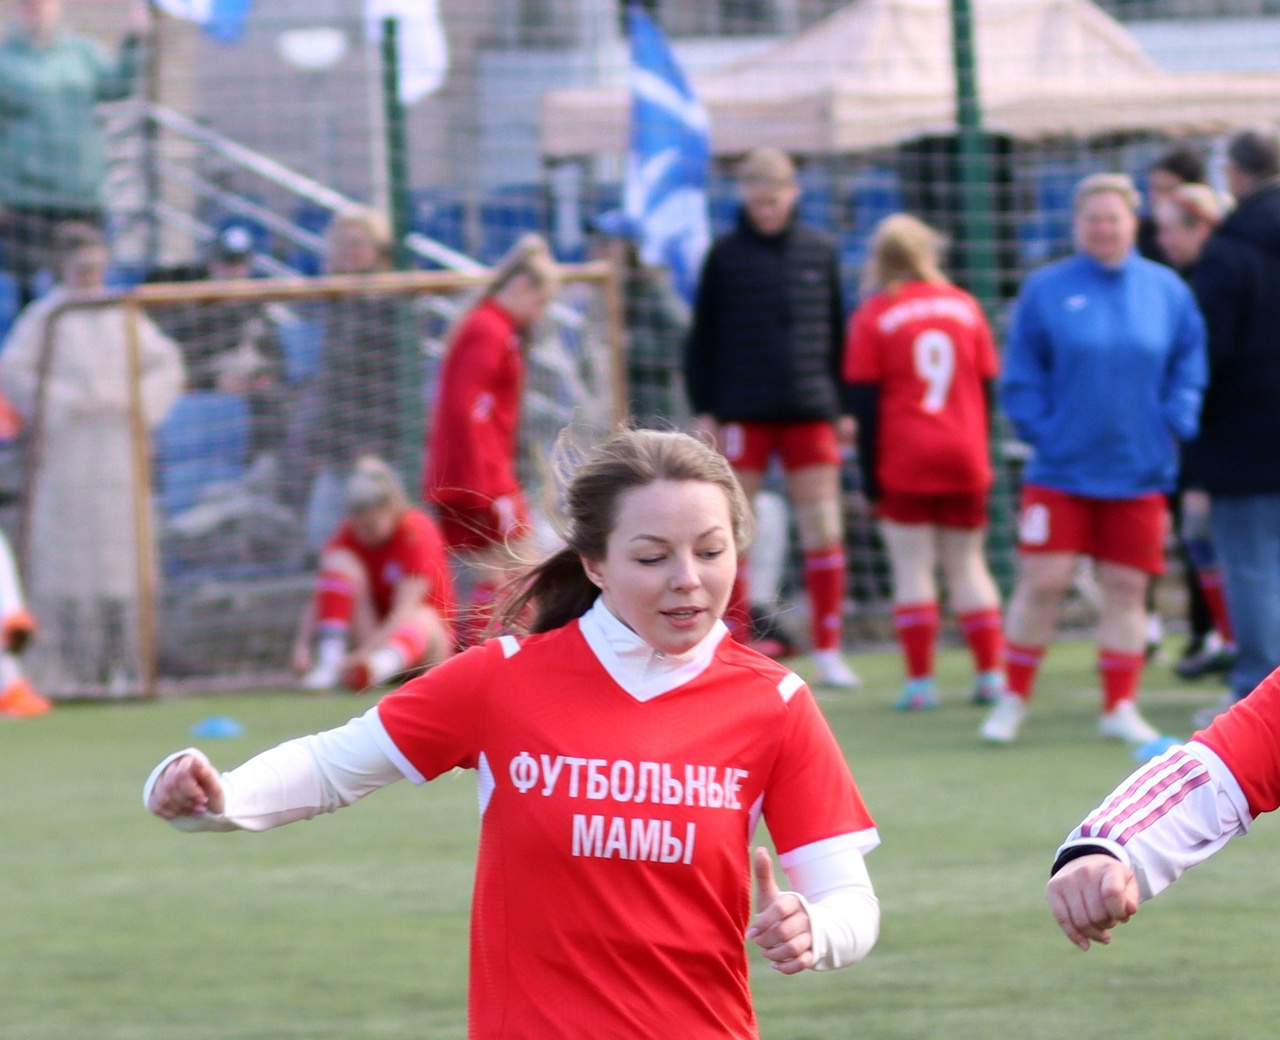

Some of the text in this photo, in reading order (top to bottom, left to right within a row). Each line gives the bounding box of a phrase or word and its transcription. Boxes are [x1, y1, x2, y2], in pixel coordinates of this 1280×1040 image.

[913, 328, 956, 414] 9
[509, 751, 749, 810] ФУТБОЛЬНЫЕ
[572, 813, 696, 865] МАМЫ
